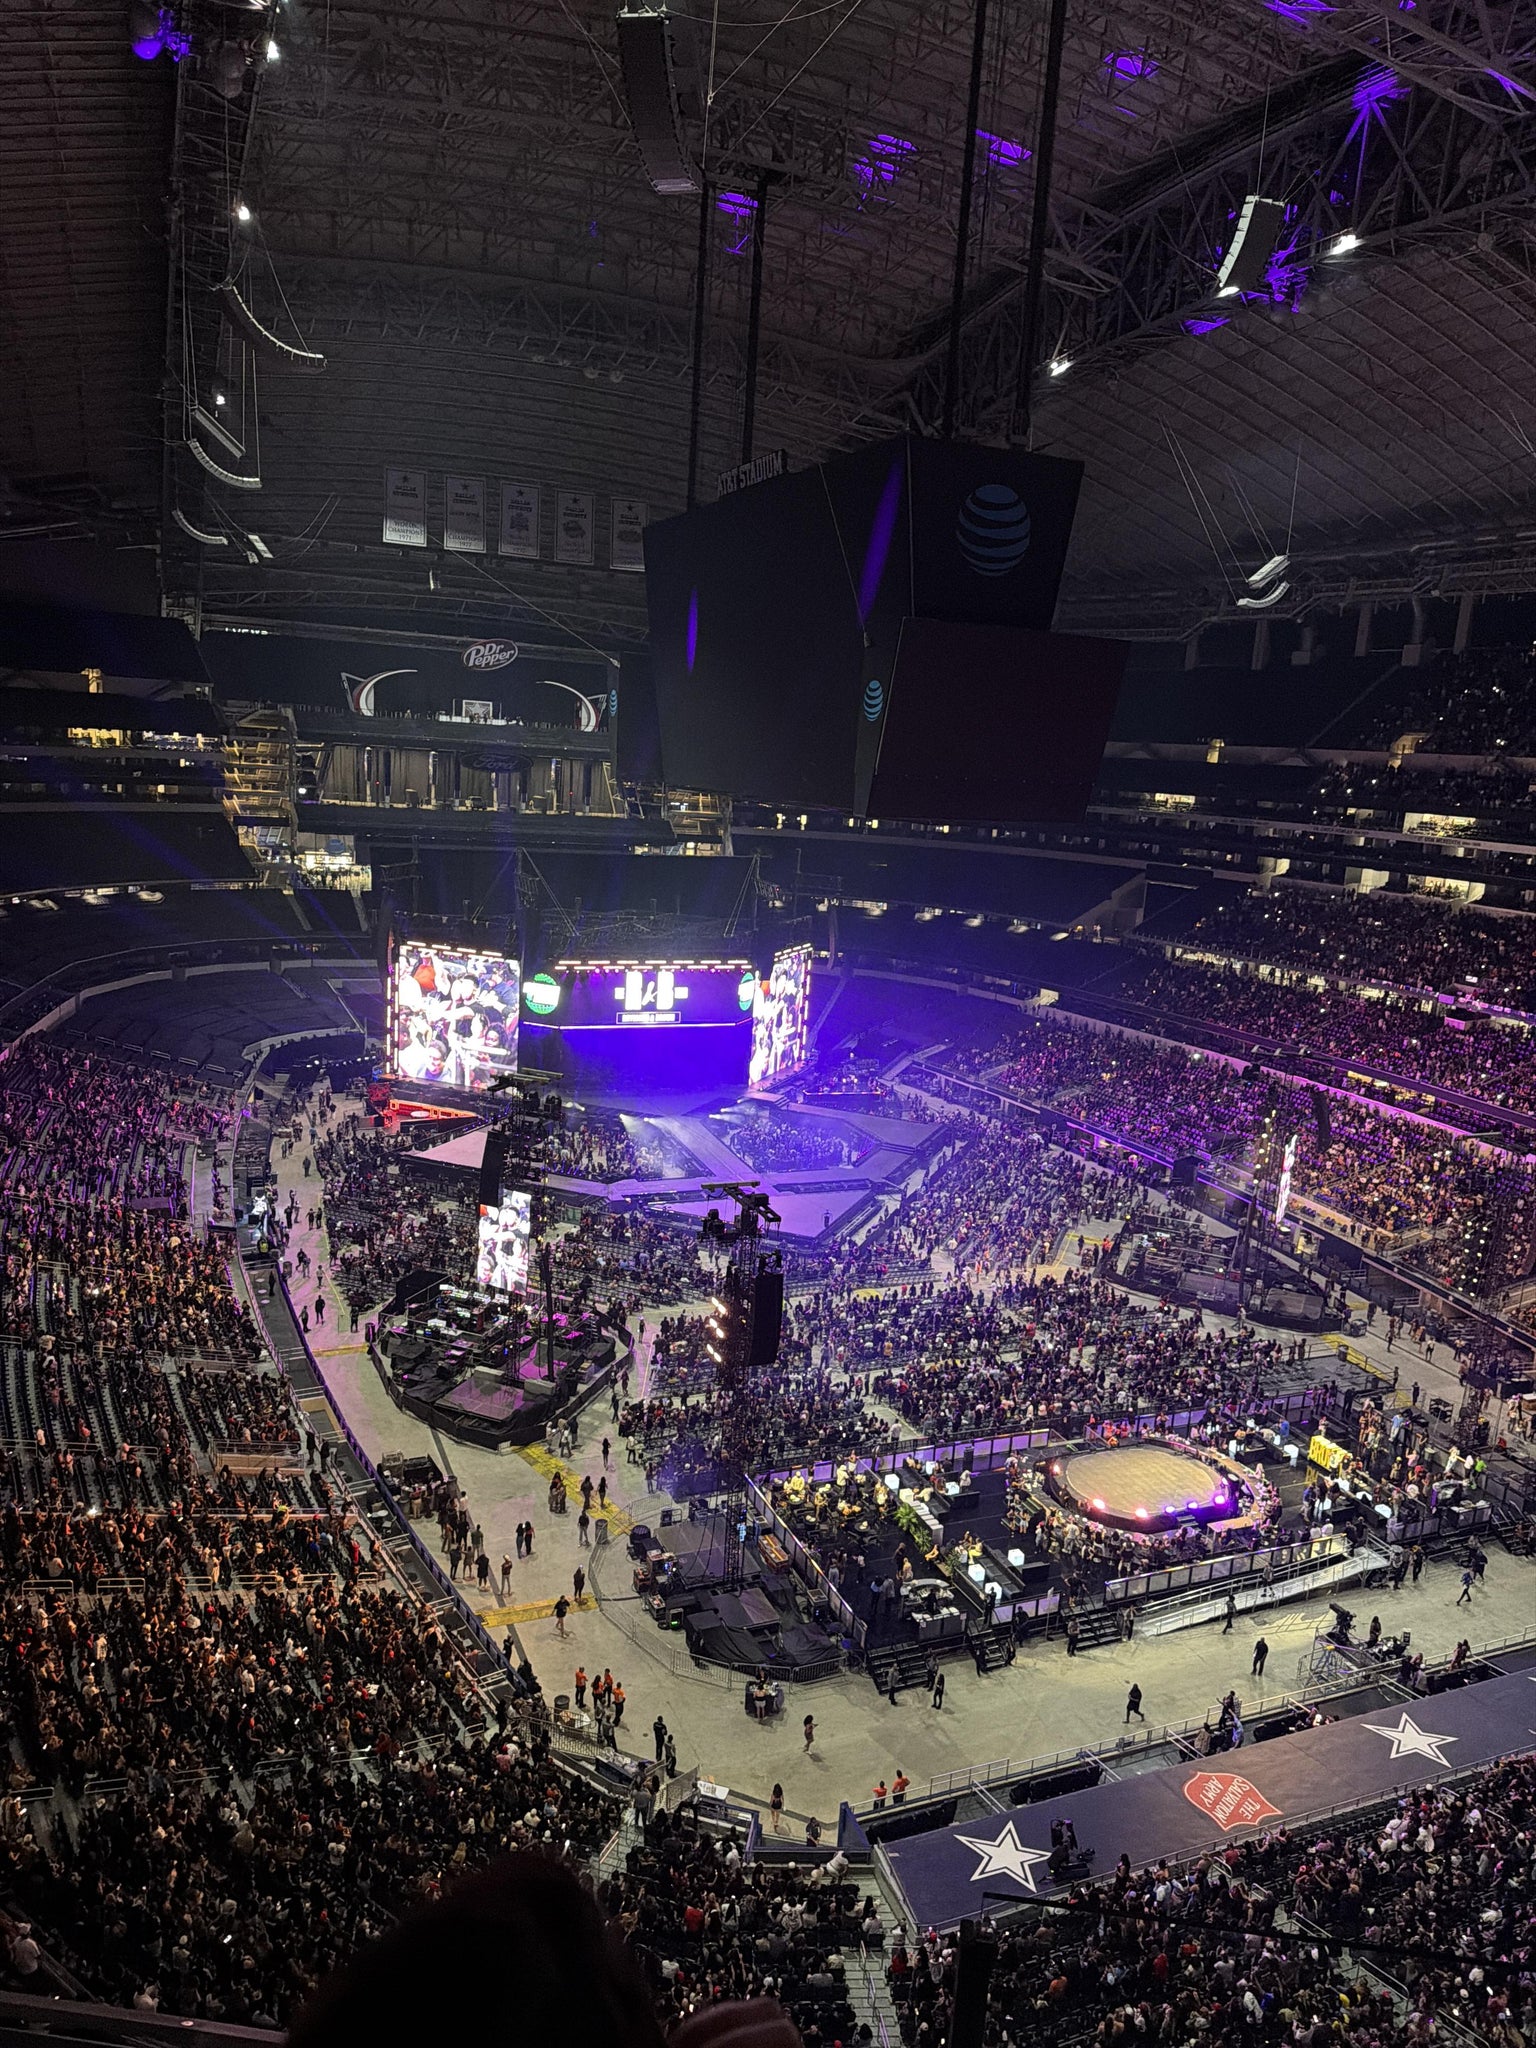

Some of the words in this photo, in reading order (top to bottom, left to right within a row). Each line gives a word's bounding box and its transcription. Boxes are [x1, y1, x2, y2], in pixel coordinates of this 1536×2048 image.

[717, 467, 738, 497] AT&T
[739, 449, 784, 489] STADIUM
[468, 645, 515, 668] Pepper
[484, 642, 505, 656] Dr
[1199, 1775, 1224, 1808] ARMY
[1211, 1777, 1250, 1824] SALVATION
[1239, 1797, 1261, 1820] THE
